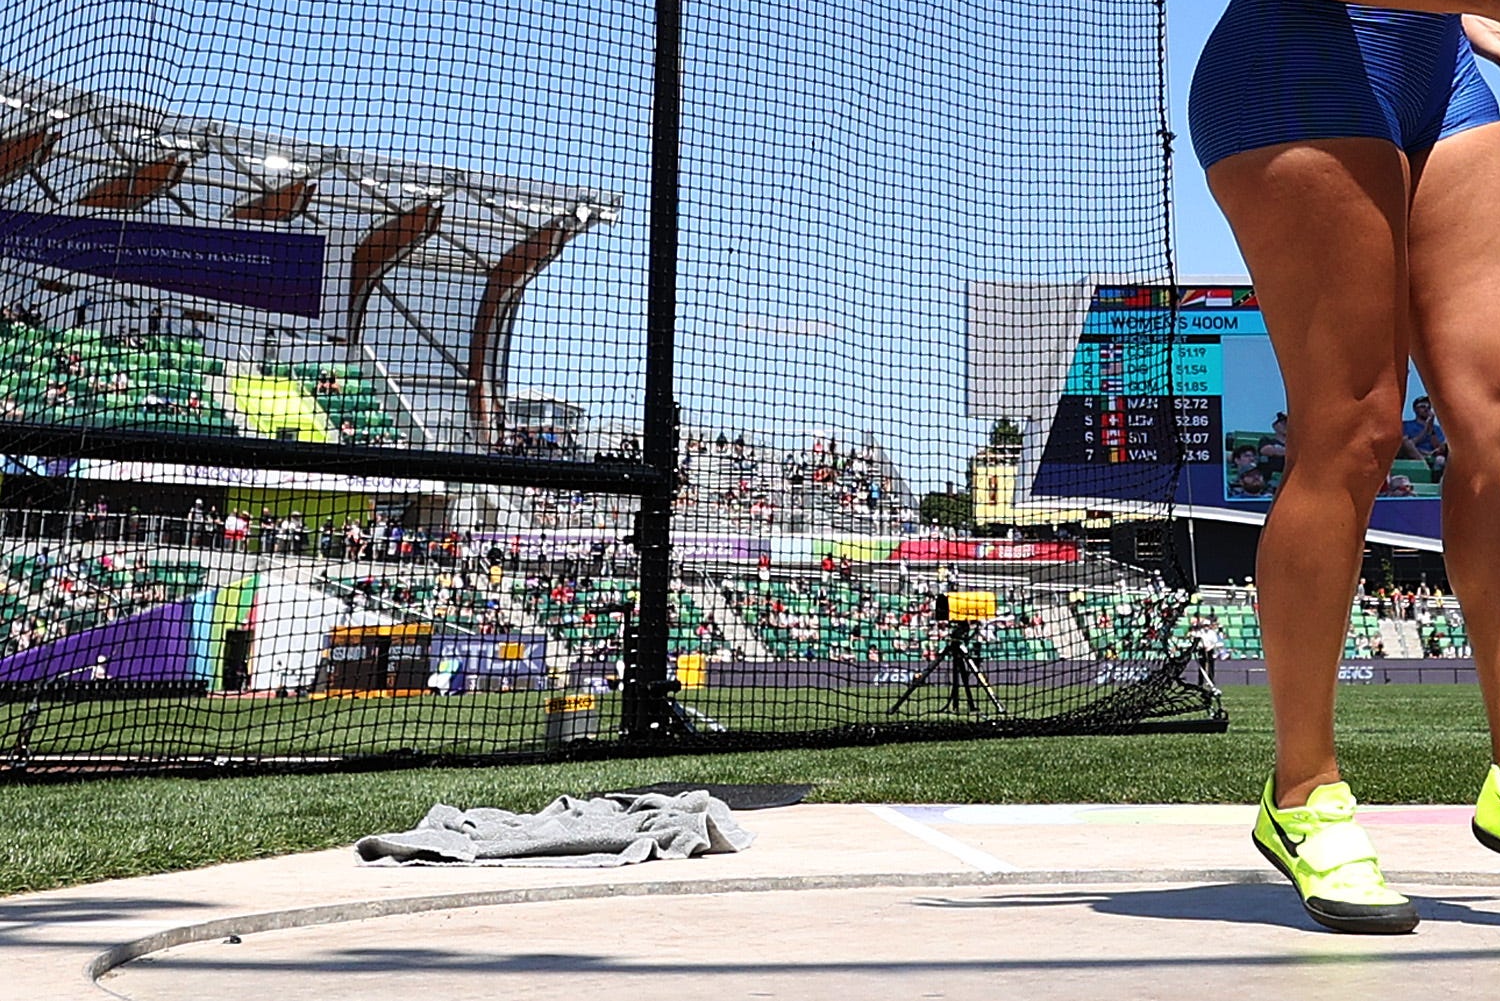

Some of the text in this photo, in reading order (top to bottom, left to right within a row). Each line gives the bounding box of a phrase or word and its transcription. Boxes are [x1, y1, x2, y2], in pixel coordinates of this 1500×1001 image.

[1110, 316, 1239, 330] WOMEN'S 400M
[1178, 347, 1207, 358] 51.19
[1176, 364, 1208, 375] 51.54
[1176, 382, 1208, 392] 51.85
[1174, 398, 1208, 409] 52.72
[1175, 415, 1209, 426] 52.86
[1085, 432, 1094, 443] 6
[1085, 449, 1094, 461] 7
[1182, 450, 1210, 461] 3.16
